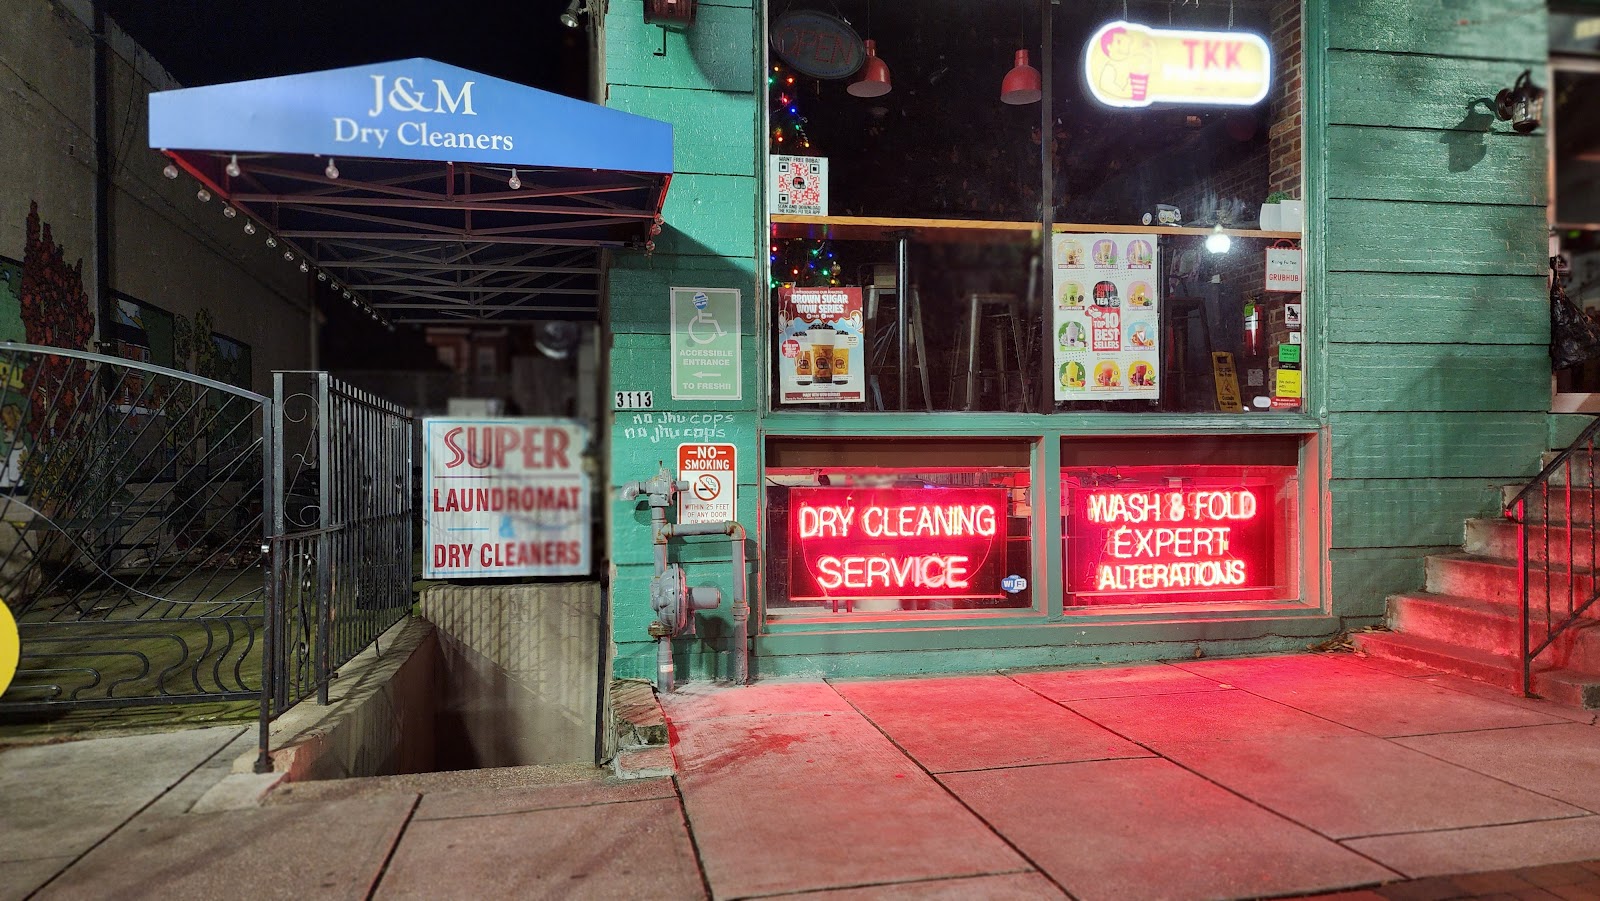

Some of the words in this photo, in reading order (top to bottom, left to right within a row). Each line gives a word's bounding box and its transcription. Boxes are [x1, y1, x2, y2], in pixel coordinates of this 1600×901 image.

[777, 26, 855, 64] OPEN
[1182, 40, 1243, 70] TKK
[368, 74, 478, 118] J&M
[333, 117, 389, 149] Dry
[397, 121, 514, 151] Cleaners
[1269, 273, 1299, 282] GRUBHUB
[791, 294, 821, 304] BROWN
[822, 294, 849, 304] SUGAR
[796, 304, 818, 313] WOW
[818, 304, 844, 314] SERIES
[1093, 320, 1105, 328] TOP
[1103, 312, 1119, 328] 10
[1093, 341, 1119, 349] SELLERS
[1094, 328, 1120, 341] BEST
[680, 349, 734, 357] ACCESSIBLE
[683, 358, 731, 366] ENTRANCE
[682, 382, 695, 390] TO
[616, 392, 652, 408] 3113
[443, 426, 571, 470] SUPER
[697, 446, 717, 459] NO
[684, 459, 730, 470] SMOKING
[433, 487, 581, 513] LAUNDROMAT
[1088, 493, 1160, 523] WASH
[1168, 493, 1185, 522] &
[1194, 491, 1257, 520] FOLD
[799, 506, 854, 538] DRY
[863, 505, 996, 537] CLEANING
[1114, 527, 1231, 558] EXPERT
[434, 543, 473, 568] DRY
[480, 541, 581, 568] CLEANERS
[817, 556, 969, 589] SERVICE
[1098, 560, 1246, 590] ALTERATIONS
